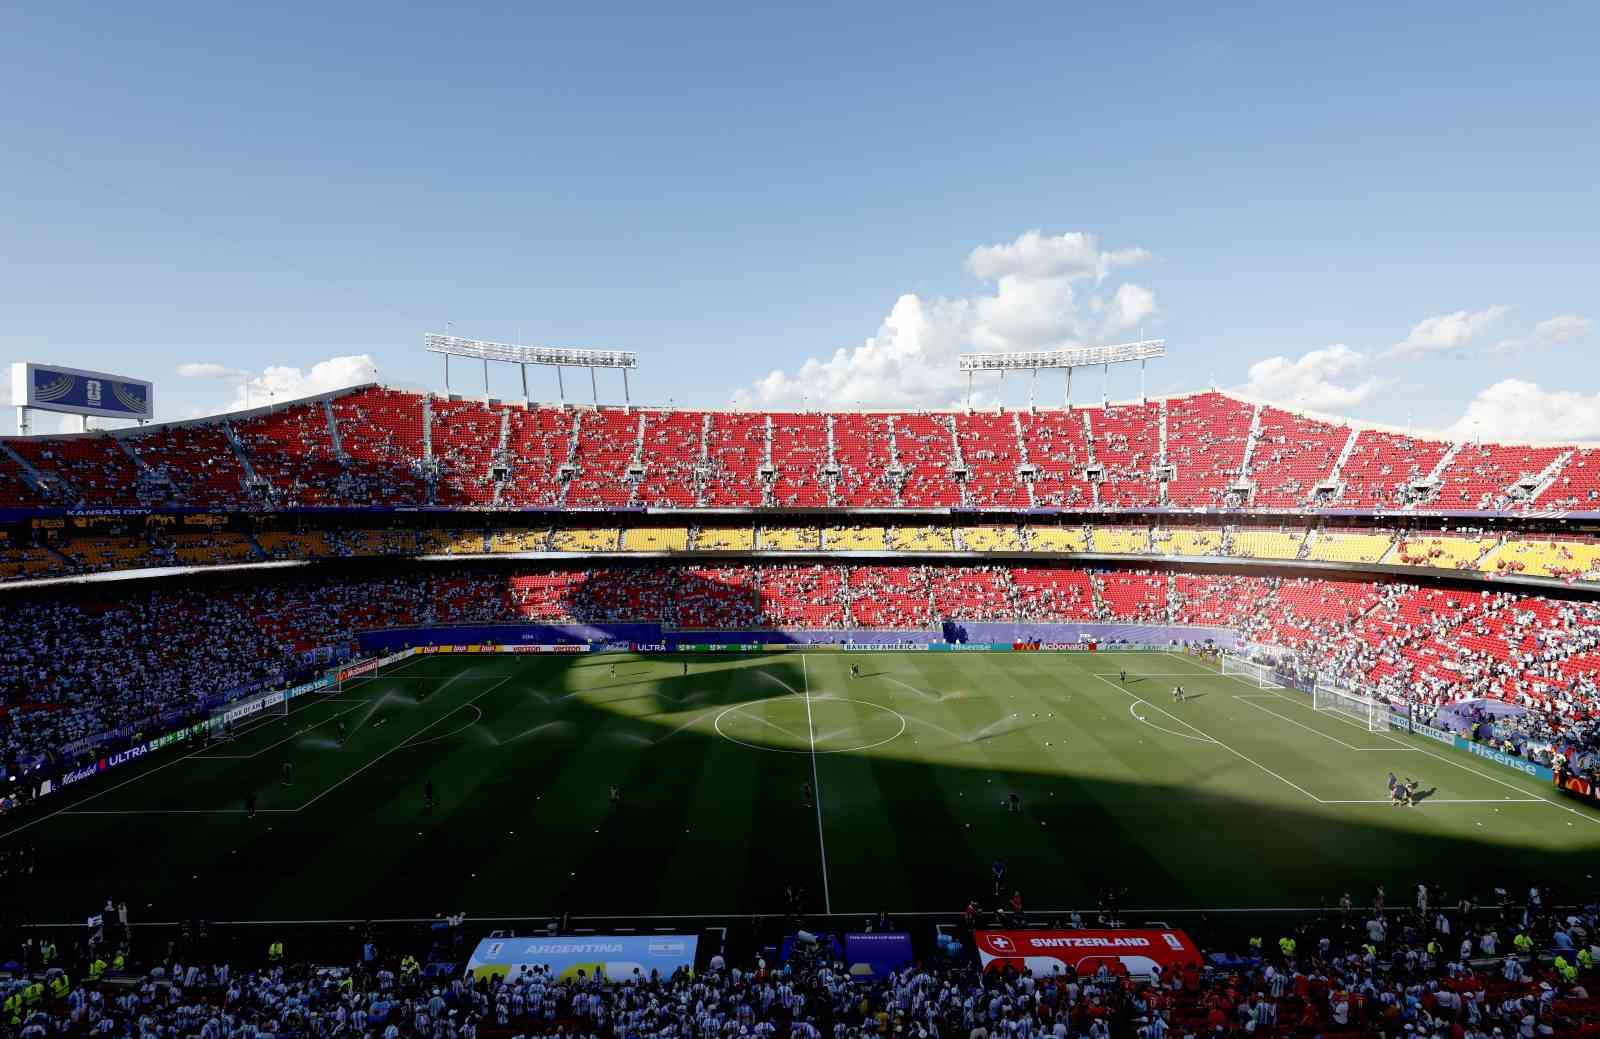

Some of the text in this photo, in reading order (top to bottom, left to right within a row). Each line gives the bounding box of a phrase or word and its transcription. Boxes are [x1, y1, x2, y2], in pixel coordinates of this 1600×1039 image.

[108, 744, 148, 767] ULTRA
[1467, 741, 1537, 776] Hisense
[526, 944, 624, 954] ARGENTINA
[1030, 937, 1151, 948] SWITZERLAND
